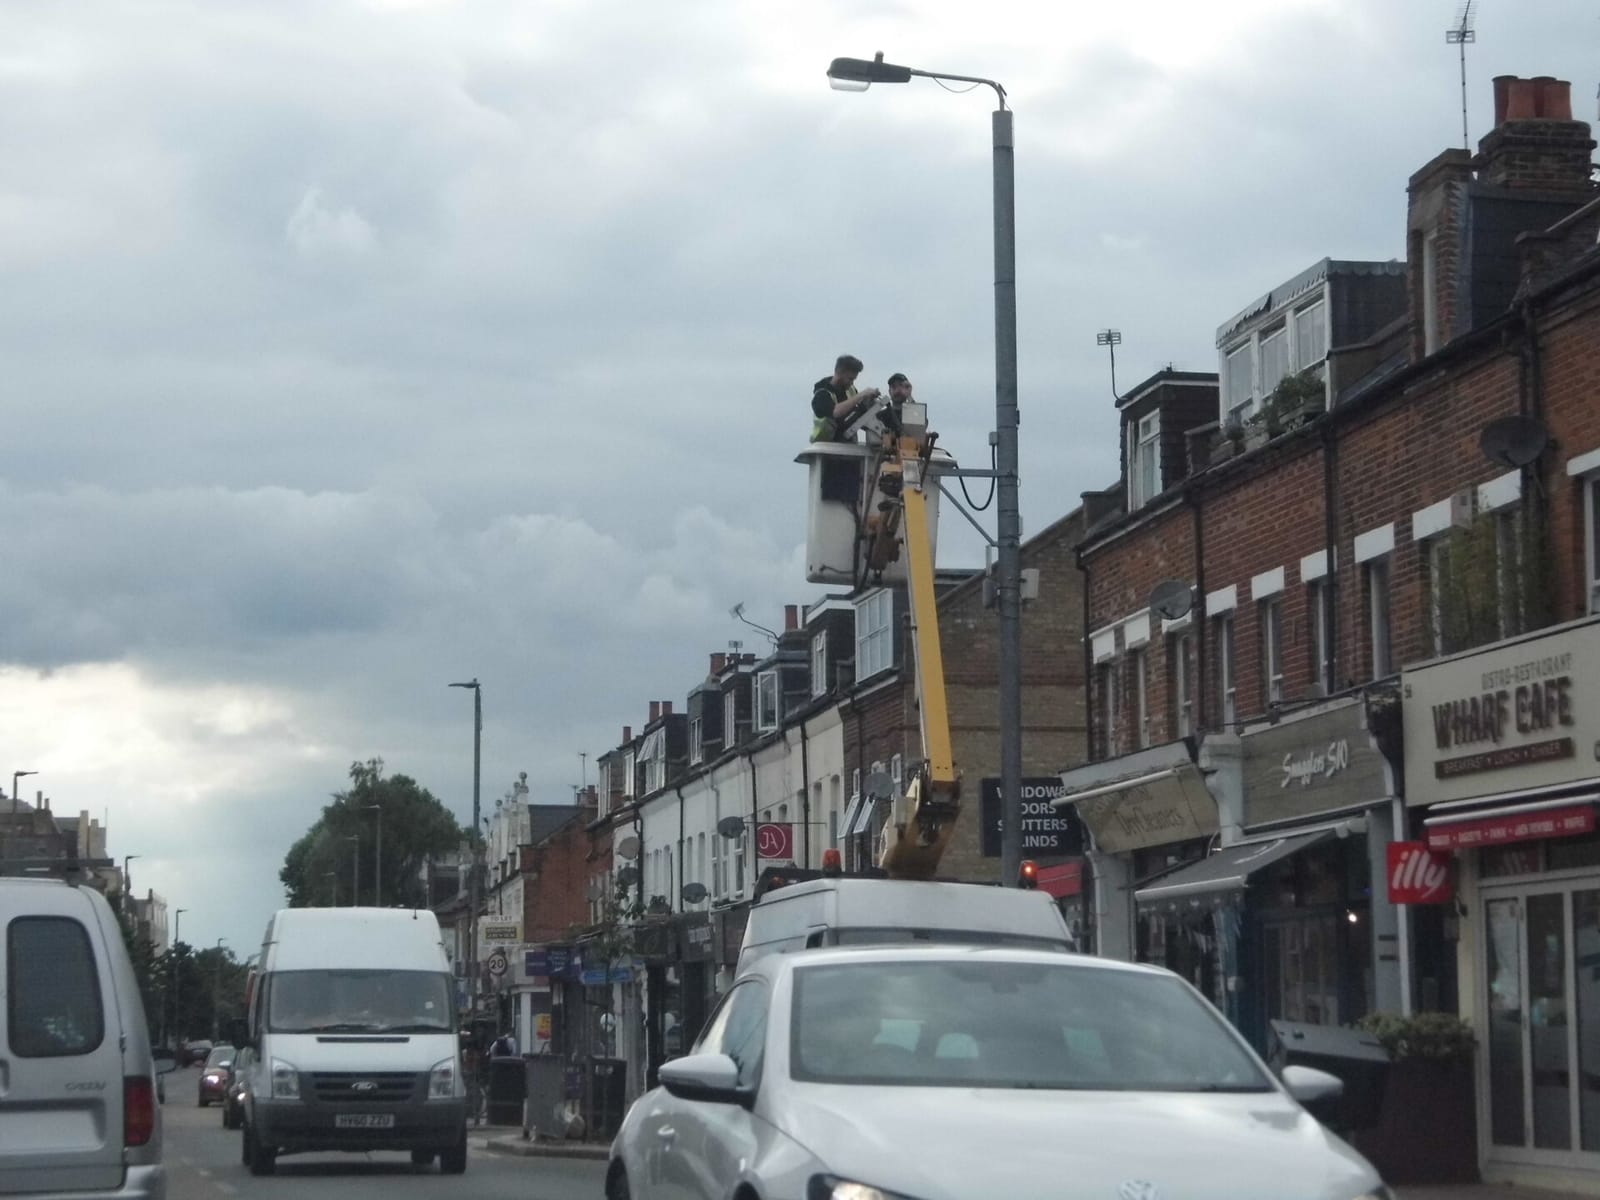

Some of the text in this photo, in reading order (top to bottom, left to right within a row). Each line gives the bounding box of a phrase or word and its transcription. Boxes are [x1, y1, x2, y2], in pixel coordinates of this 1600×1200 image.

[1432, 676, 1574, 749] WHARF CAFE
[1391, 848, 1447, 898] illy
[490, 958, 504, 969] 20
